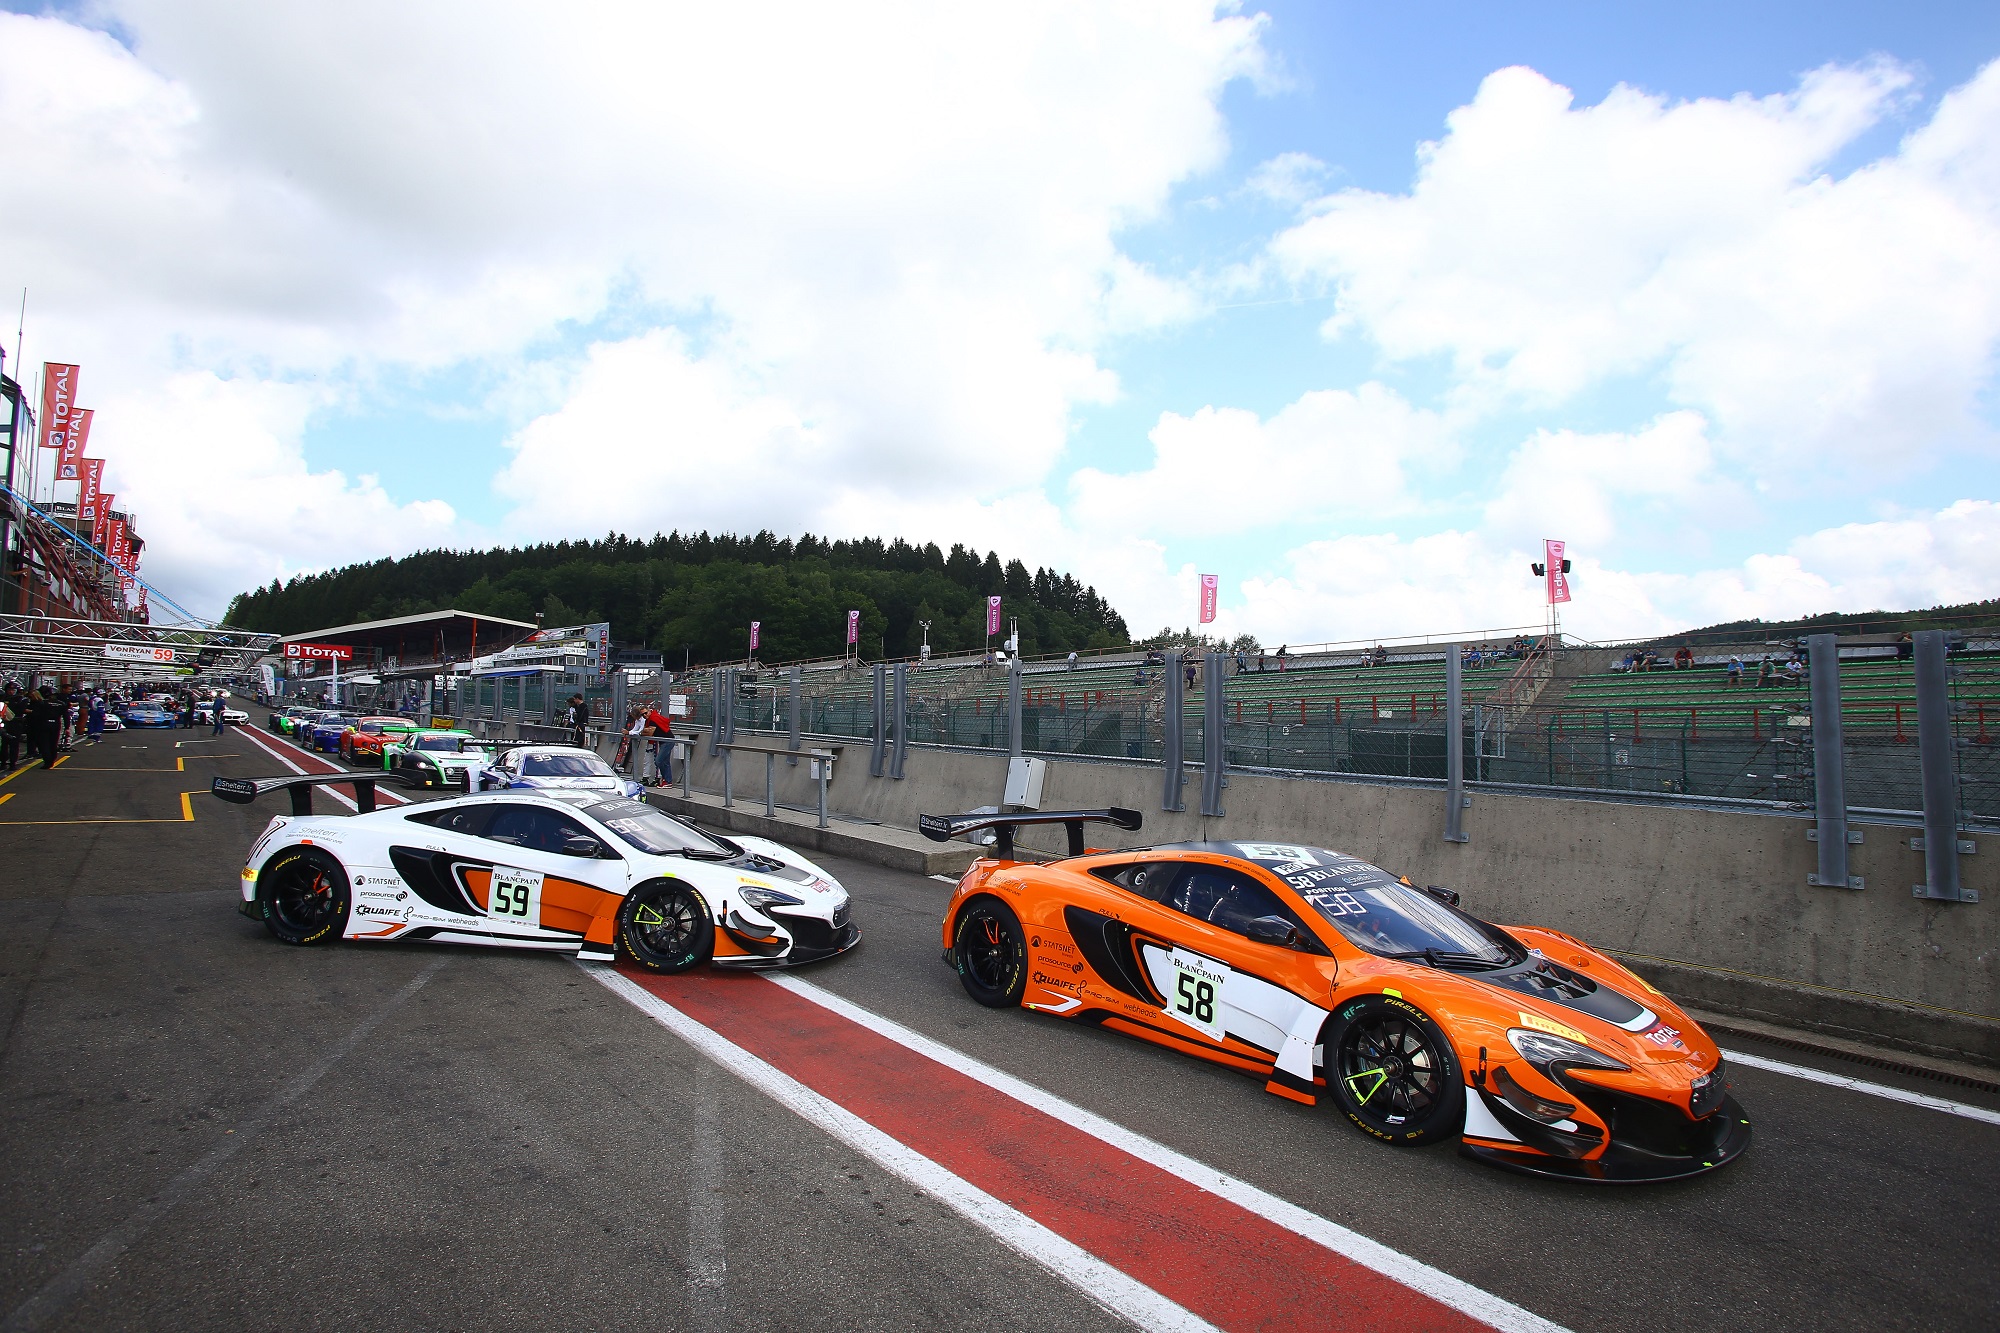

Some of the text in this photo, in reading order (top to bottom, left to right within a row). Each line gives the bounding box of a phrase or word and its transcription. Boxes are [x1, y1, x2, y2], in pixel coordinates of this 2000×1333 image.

[53, 366, 70, 428] TOTAL
[65, 410, 85, 462] TOTAL
[85, 460, 99, 504] TOTAL
[97, 495, 110, 532] TOTAL
[112, 521, 123, 554] TOTAL
[1553, 559, 1564, 599] la deux
[153, 648, 173, 661] 59
[303, 646, 350, 658] TOTAL
[604, 818, 644, 834] 59
[1253, 846, 1301, 858] 58
[367, 877, 401, 886] STATSNET
[494, 872, 540, 886] BLANCPAIN
[1286, 875, 1316, 890] 58
[1305, 886, 1348, 895] POSITION
[494, 881, 530, 917] 59
[1316, 893, 1368, 917] 58
[355, 904, 402, 917] QUAIFE
[1099, 908, 1114, 918] PULL
[447, 917, 480, 927] webheads
[1043, 940, 1076, 955] STATSNET
[1037, 955, 1071, 969] prosource
[1173, 958, 1225, 985] BLANCPAIN
[1031, 970, 1077, 991] QUAIFE
[1084, 989, 1120, 1005] PRO-SIM
[1177, 971, 1214, 1024] 58
[1123, 1003, 1157, 1019] webheads
[1342, 1005, 1355, 1021] RF
[1384, 997, 1429, 1023] PIRELLI
[1526, 1016, 1580, 1039] PIRELLI
[1644, 1025, 1681, 1046] TOTAL
